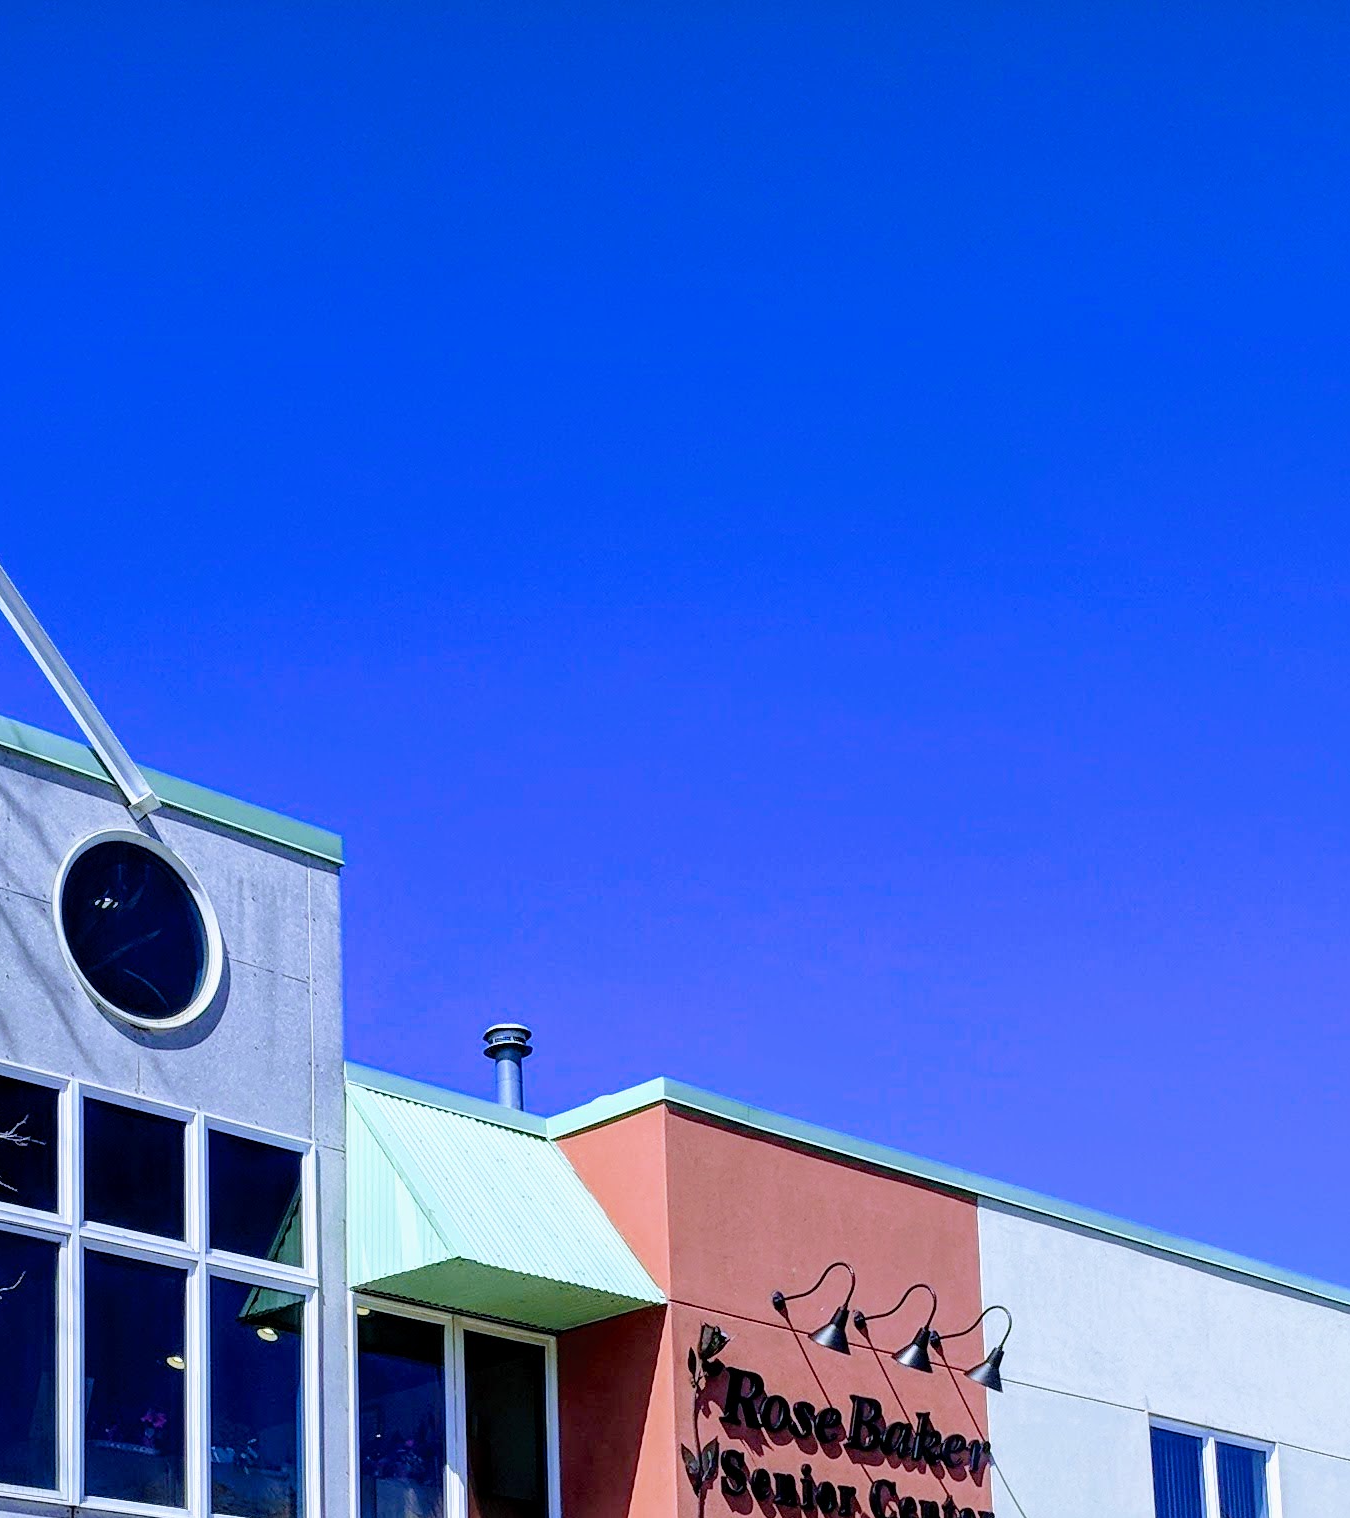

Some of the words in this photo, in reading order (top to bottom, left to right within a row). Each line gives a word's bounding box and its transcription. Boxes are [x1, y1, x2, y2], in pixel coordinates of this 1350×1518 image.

[719, 1366, 842, 1443] Rose
[844, 1394, 991, 1472] Baker
[720, 1449, 857, 1517] Senior
